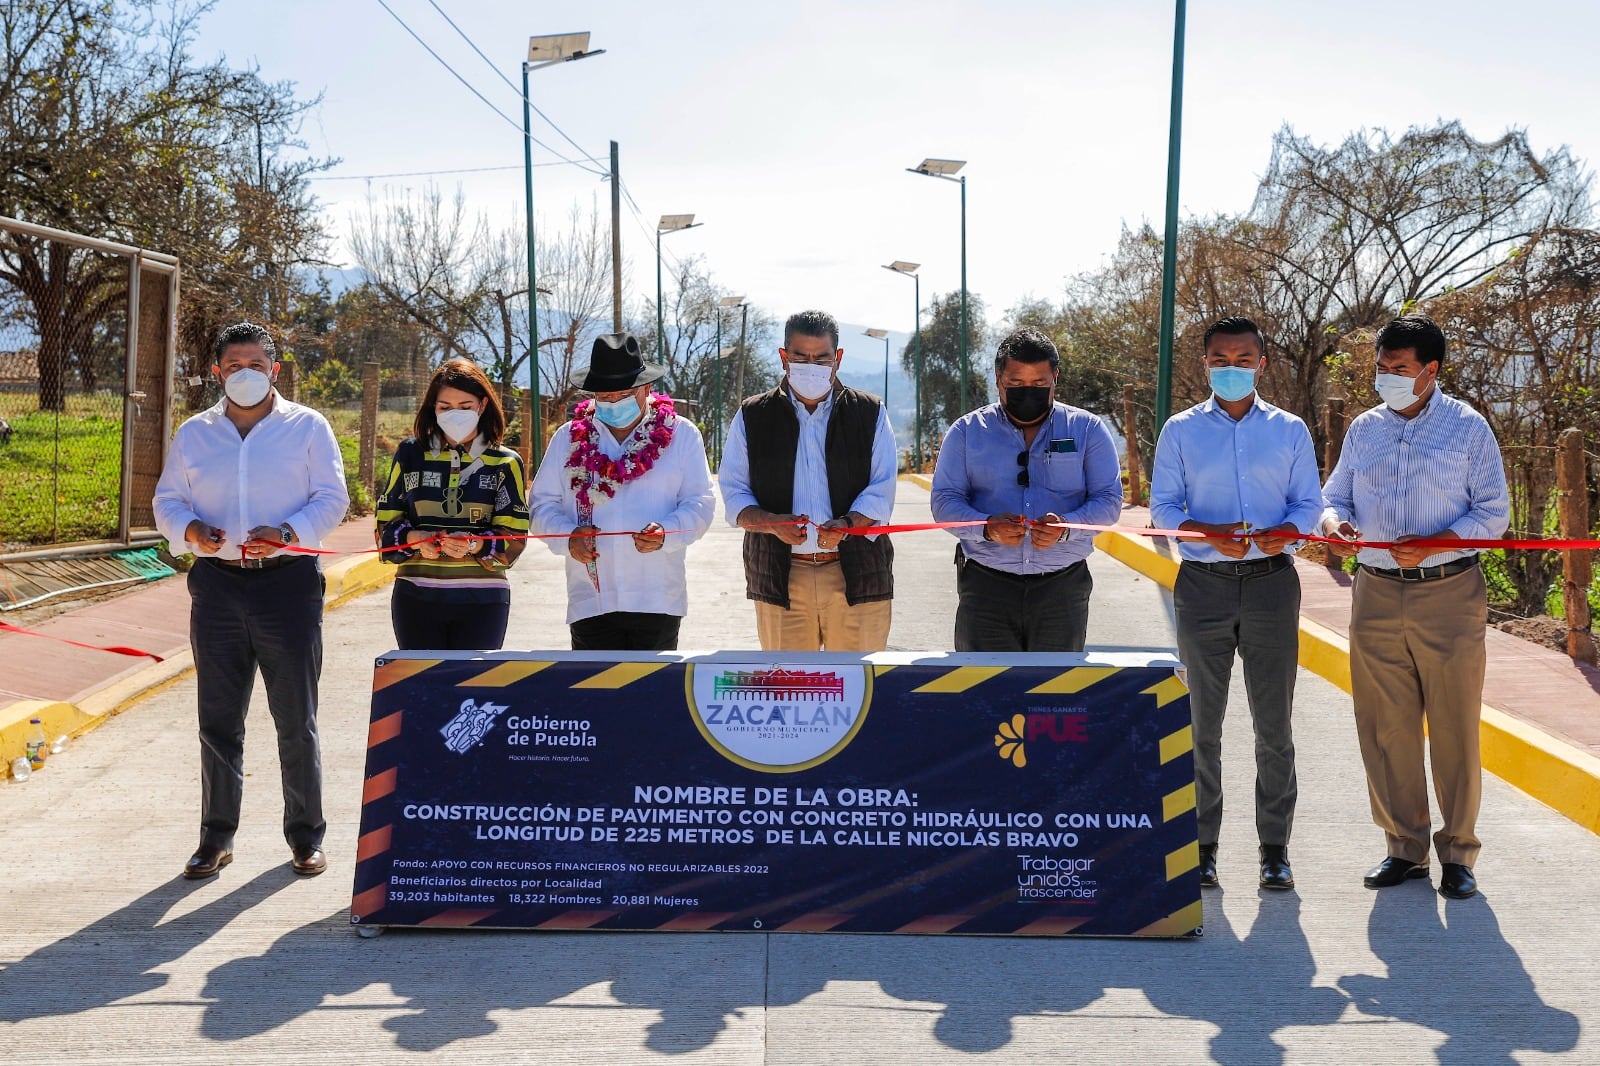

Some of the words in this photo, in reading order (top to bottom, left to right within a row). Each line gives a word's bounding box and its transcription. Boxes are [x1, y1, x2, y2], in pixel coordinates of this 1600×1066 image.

[706, 701, 850, 726] ZACATLÁN
[507, 715, 591, 730] Gobierno
[1027, 714, 1089, 742] PUE
[507, 731, 530, 745] de
[535, 731, 597, 747] Puebla
[634, 785, 746, 805] NOMBRE
[754, 787, 788, 806] DE
[796, 787, 830, 806] LA
[837, 788, 918, 807] OBRA:
[403, 803, 571, 822] CONSTRUCCIÓN
[577, 807, 605, 822] DE
[611, 808, 733, 824] PAVIMENTO
[738, 810, 784, 825] CON
[790, 811, 907, 826] CONCRETO
[913, 808, 1043, 828] HIDRÁULICO
[1054, 813, 1100, 828] CON
[1106, 813, 1153, 829] UNA
[476, 825, 585, 841] LONGITUD
[590, 827, 619, 842] DE
[624, 827, 661, 843] 225
[667, 828, 755, 844] METROS
[766, 829, 794, 844] DE
[800, 830, 827, 845] LA
[833, 830, 901, 846] CALLE
[907, 828, 1000, 847] NICOLÁS
[1007, 832, 1079, 848] BRAVO
[393, 859, 428, 868] Fondo:
[430, 860, 467, 869] APOYO
[470, 861, 493, 869] CON
[496, 861, 552, 870] RECURSOS
[555, 862, 626, 872] FINANCIEROS
[629, 863, 645, 872] NO
[648, 864, 741, 873] REGULARIZABLES
[743, 865, 769, 874] 2022
[1017, 855, 1096, 876] Trabajar
[391, 876, 467, 886] Beneficiarios
[470, 877, 518, 887] directos
[521, 879, 541, 889] por
[545, 878, 602, 888] Localidad
[1017, 870, 1081, 887] unidos
[389, 891, 430, 902] 39,203
[433, 892, 495, 903] habitantes
[508, 894, 545, 905] 18,322
[549, 894, 601, 904] Hombres
[612, 895, 650, 906] 20,881
[654, 895, 699, 907] Mujeres
[1017, 886, 1098, 898] trascender
